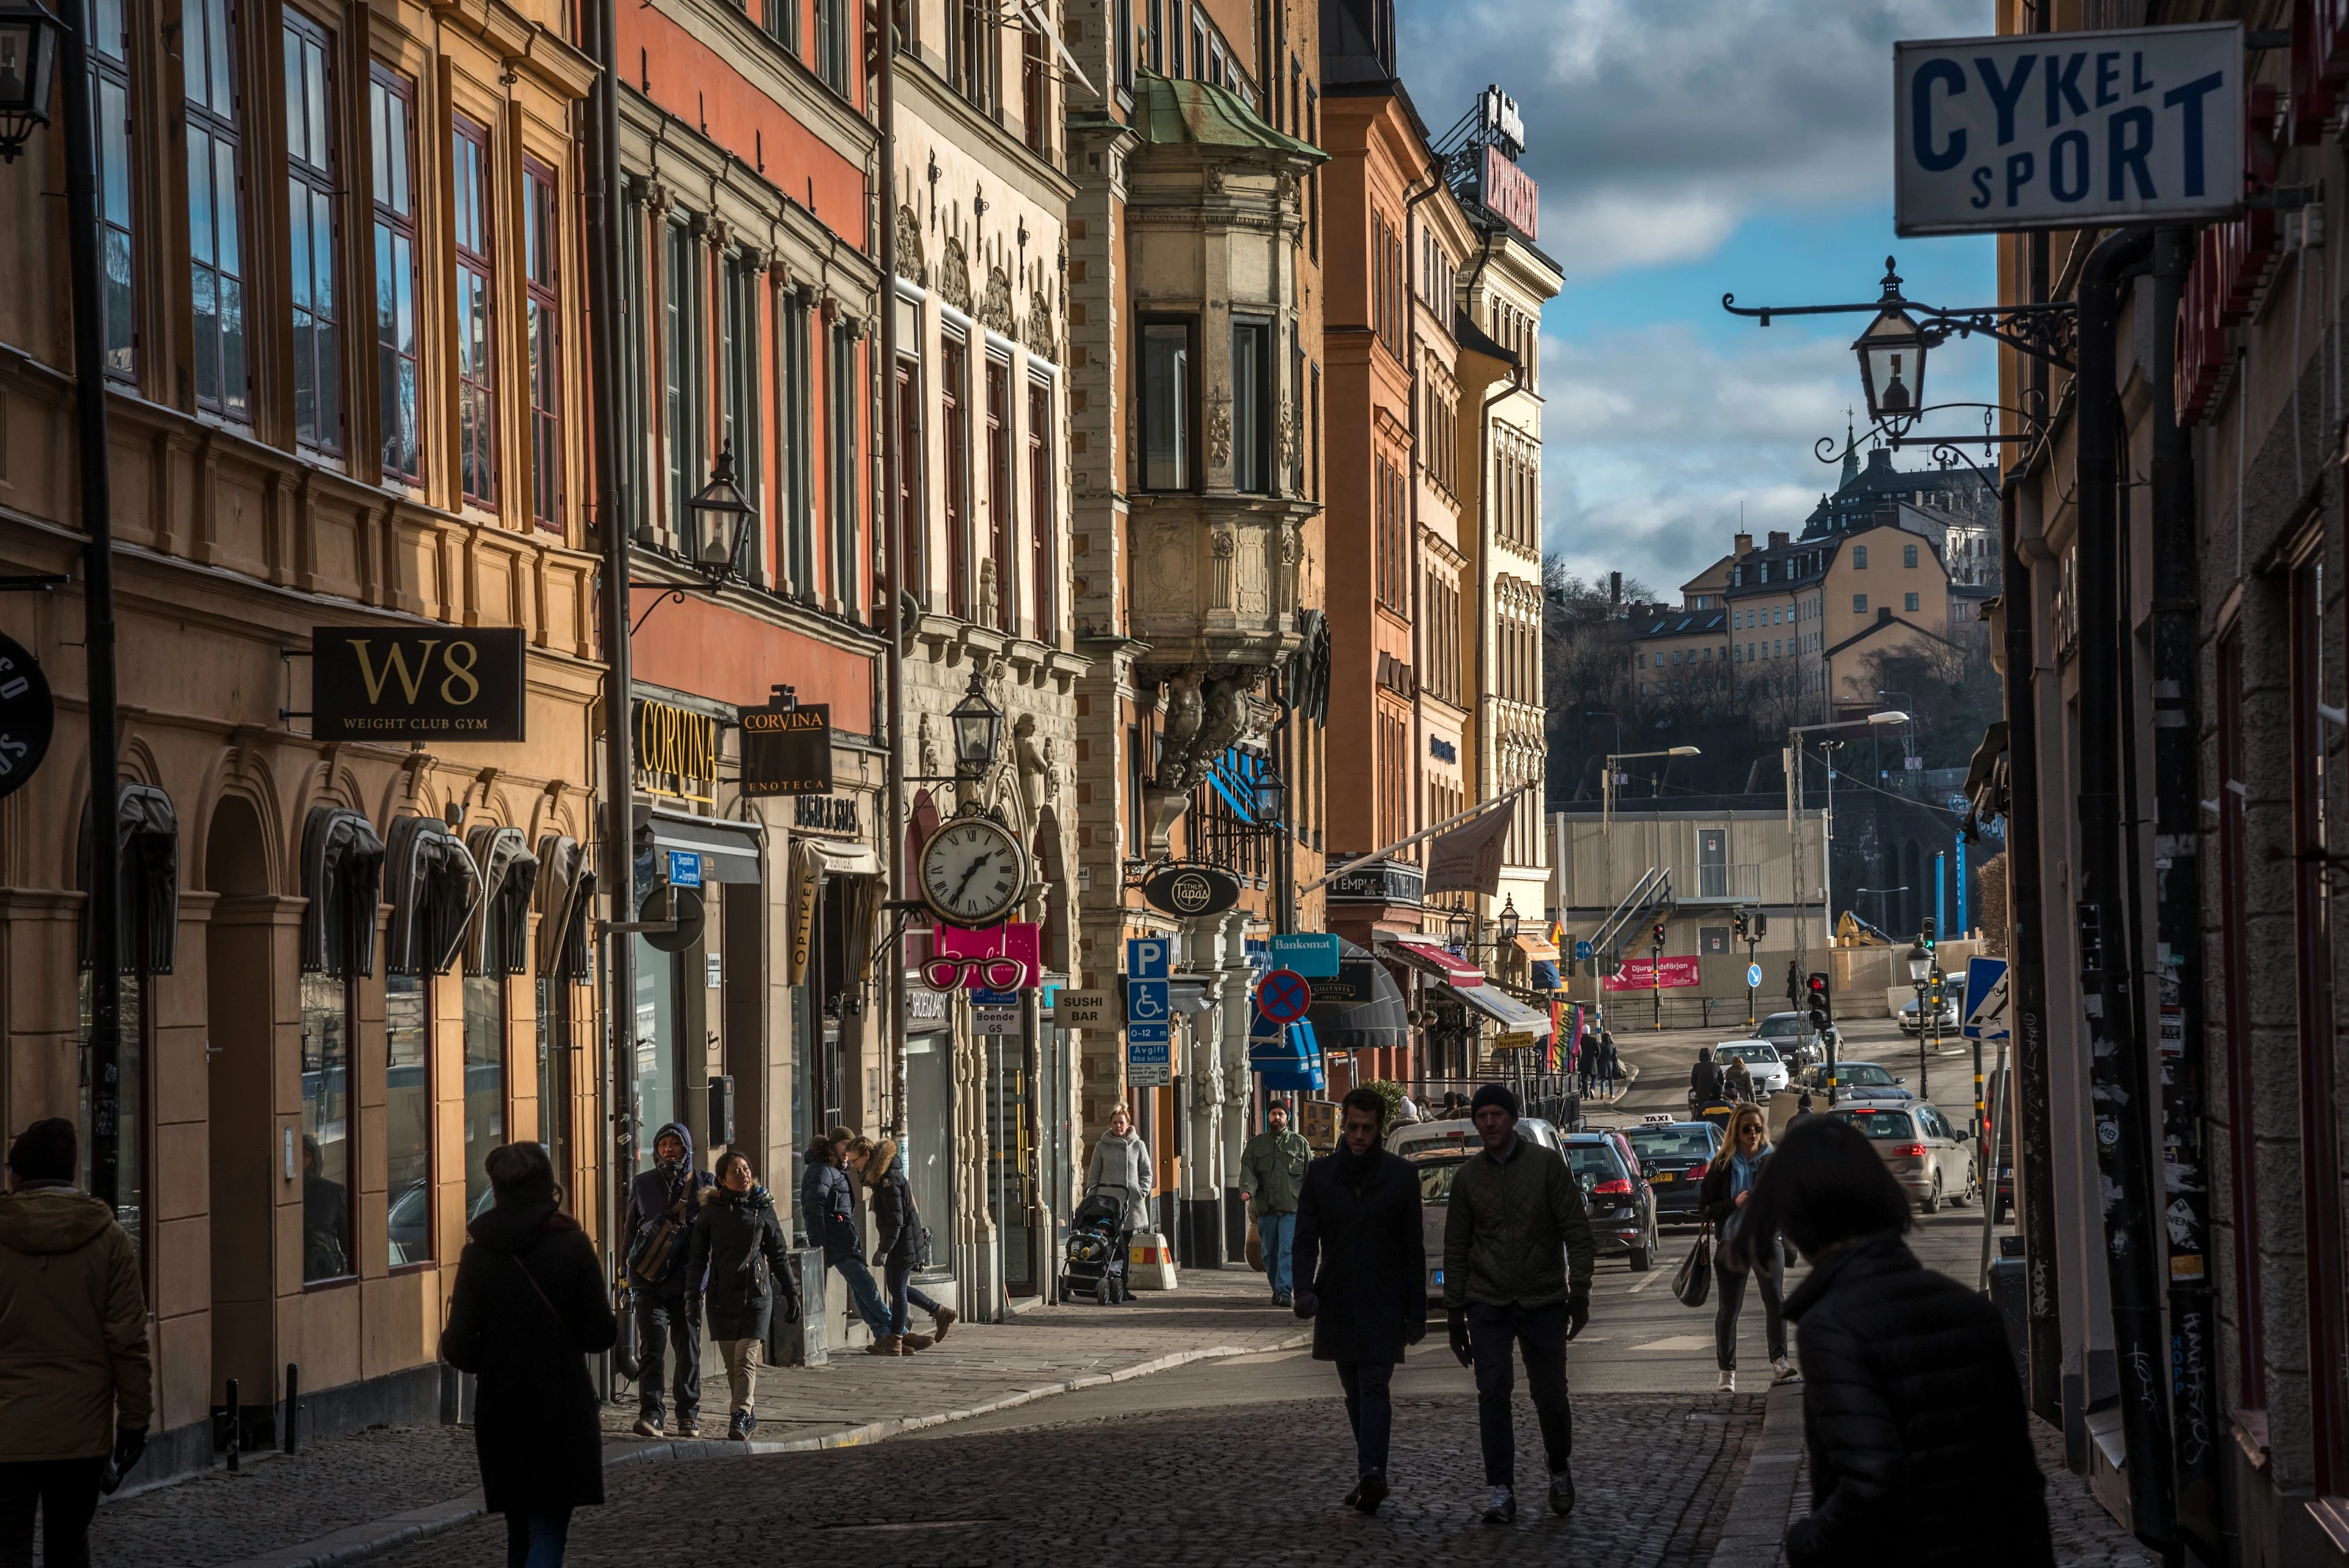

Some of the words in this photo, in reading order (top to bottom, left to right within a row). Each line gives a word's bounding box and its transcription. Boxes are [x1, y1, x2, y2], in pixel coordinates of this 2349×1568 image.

[1912, 51, 2154, 172] CYKEL
[1970, 70, 2223, 209] SPORT
[1487, 144, 1538, 241] EXPRESSEN
[346, 639, 479, 705] W8
[344, 718, 406, 729] WEIGHT
[410, 718, 450, 729] CLUB
[455, 718, 488, 729] GYM
[744, 712, 823, 731] CORVINA
[642, 699, 717, 795] CORVINA
[749, 780, 824, 792] ENOTECA
[1174, 883, 1210, 904] Tapas
[795, 874, 815, 965] OPTIKER
[1275, 938, 1330, 950] Bankomat
[1138, 943, 1160, 975] P
[913, 992, 929, 1017] SHOES
[932, 992, 947, 1019] BAGS
[1064, 997, 1102, 1006] SUSHI
[1072, 1012, 1097, 1020] BAR
[989, 1024, 1002, 1033] GS
[1135, 1046, 1163, 1055] Avgift
